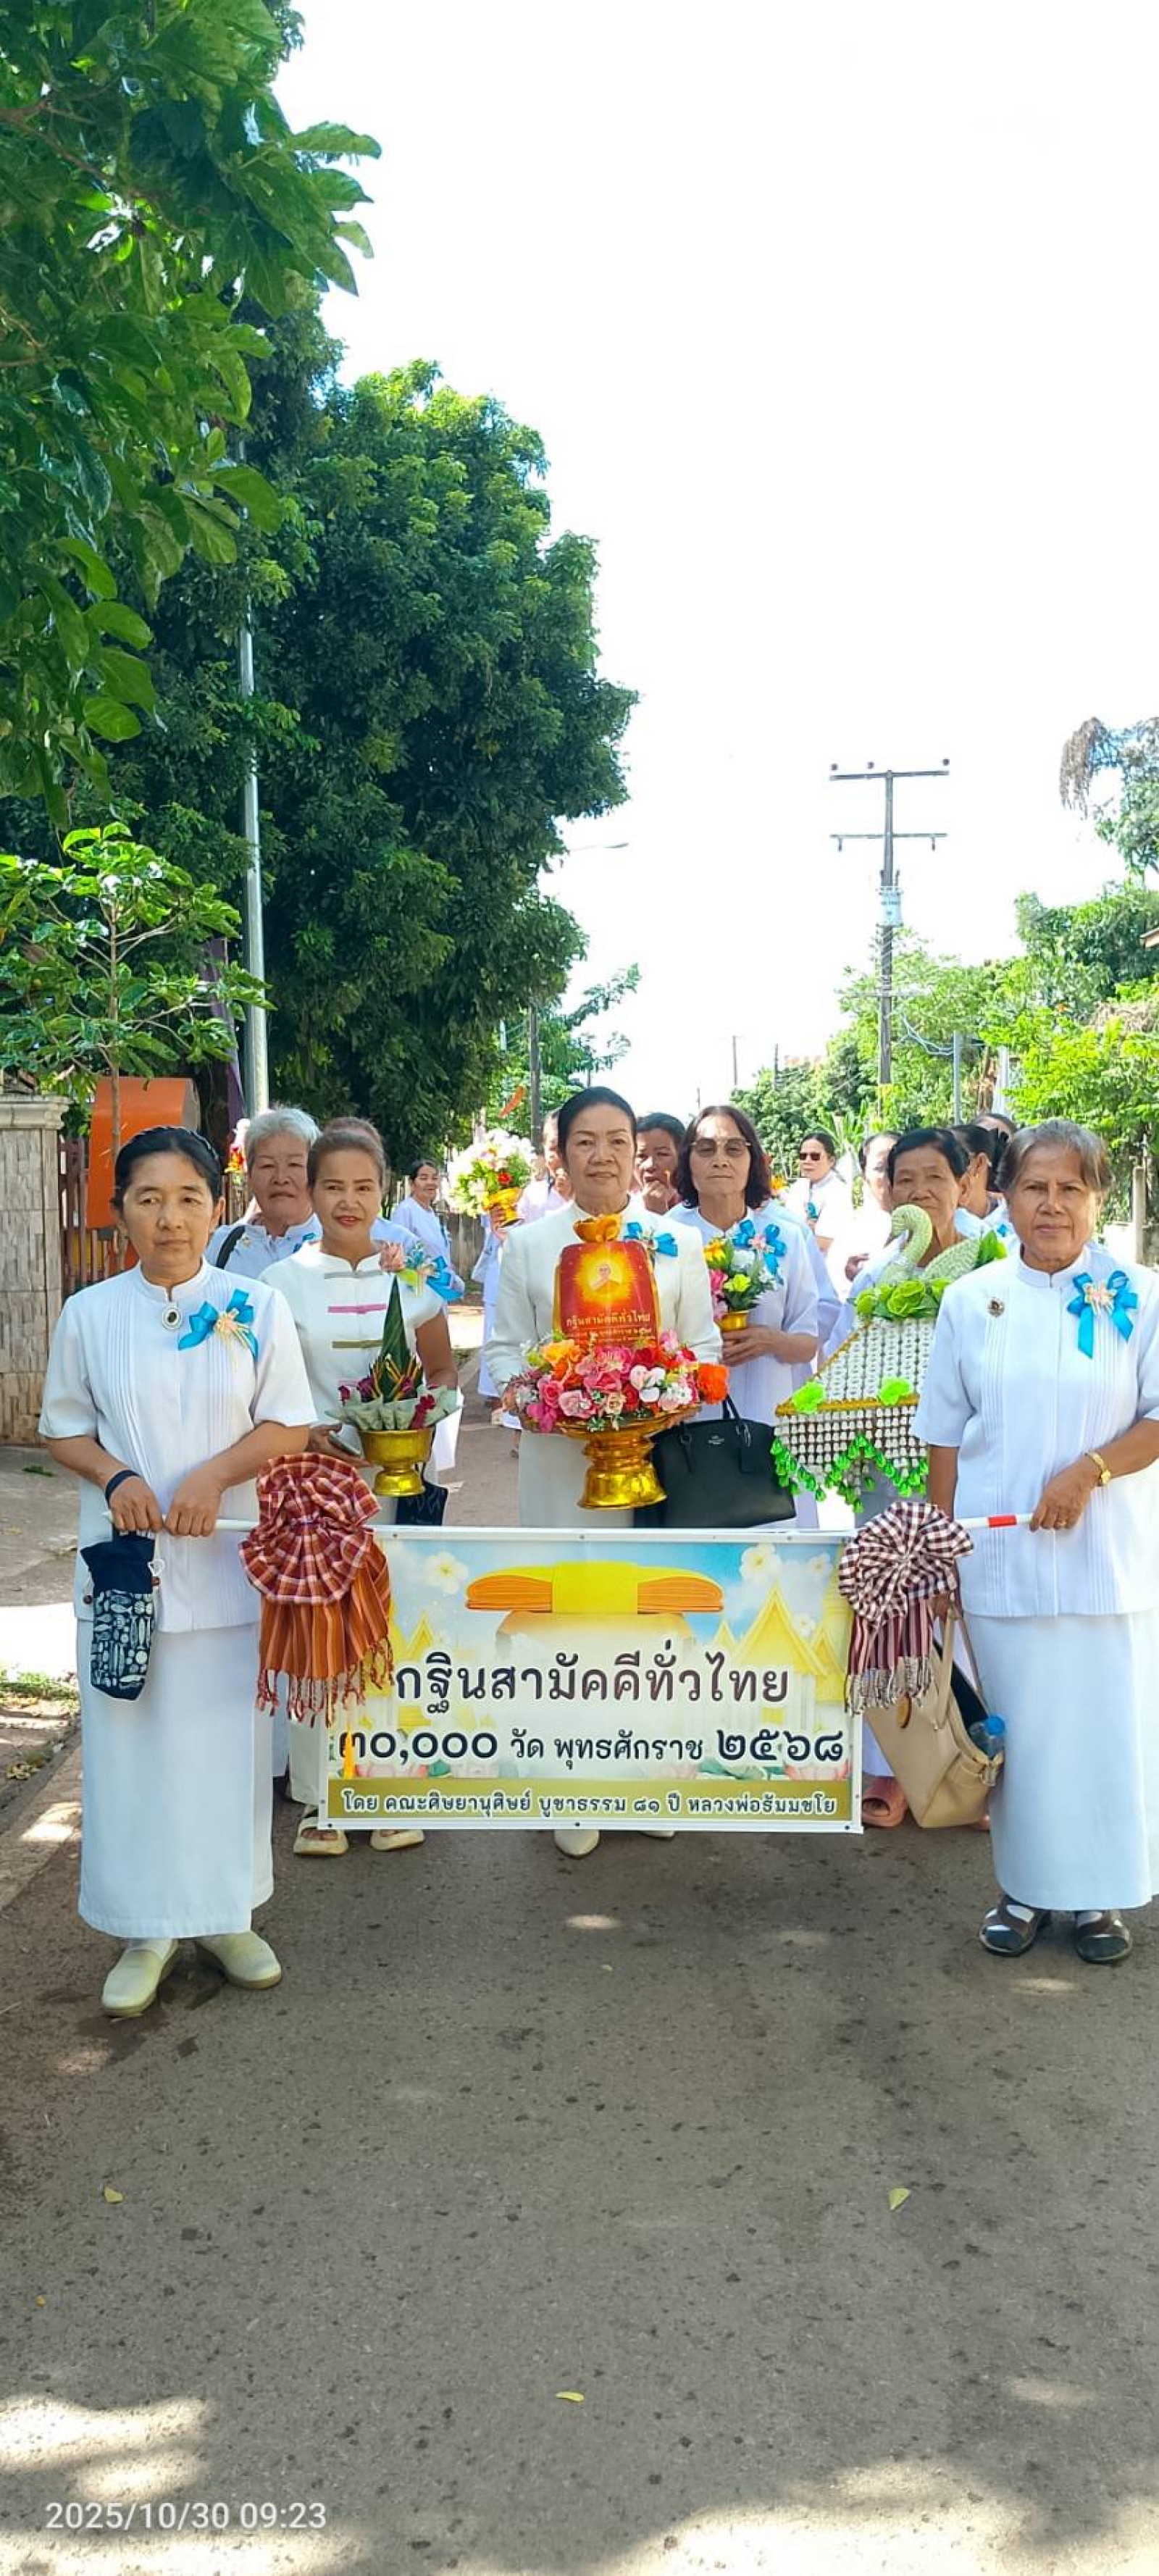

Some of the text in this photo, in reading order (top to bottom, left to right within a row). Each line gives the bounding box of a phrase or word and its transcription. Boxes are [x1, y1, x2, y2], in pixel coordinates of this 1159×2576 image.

[396, 1639, 789, 1714] กฐินสามัคคีทั่วไทย
[510, 1728, 544, 1759] วัด
[554, 1729, 703, 1770] พุทธศักราช
[716, 1729, 844, 1762] ๒๕๖๘
[343, 1789, 835, 1818] โดย คณะศิษยานุศิษย์ บูชาธรรม ๘๑ ปี หลวงพ่อธัมมชโย
